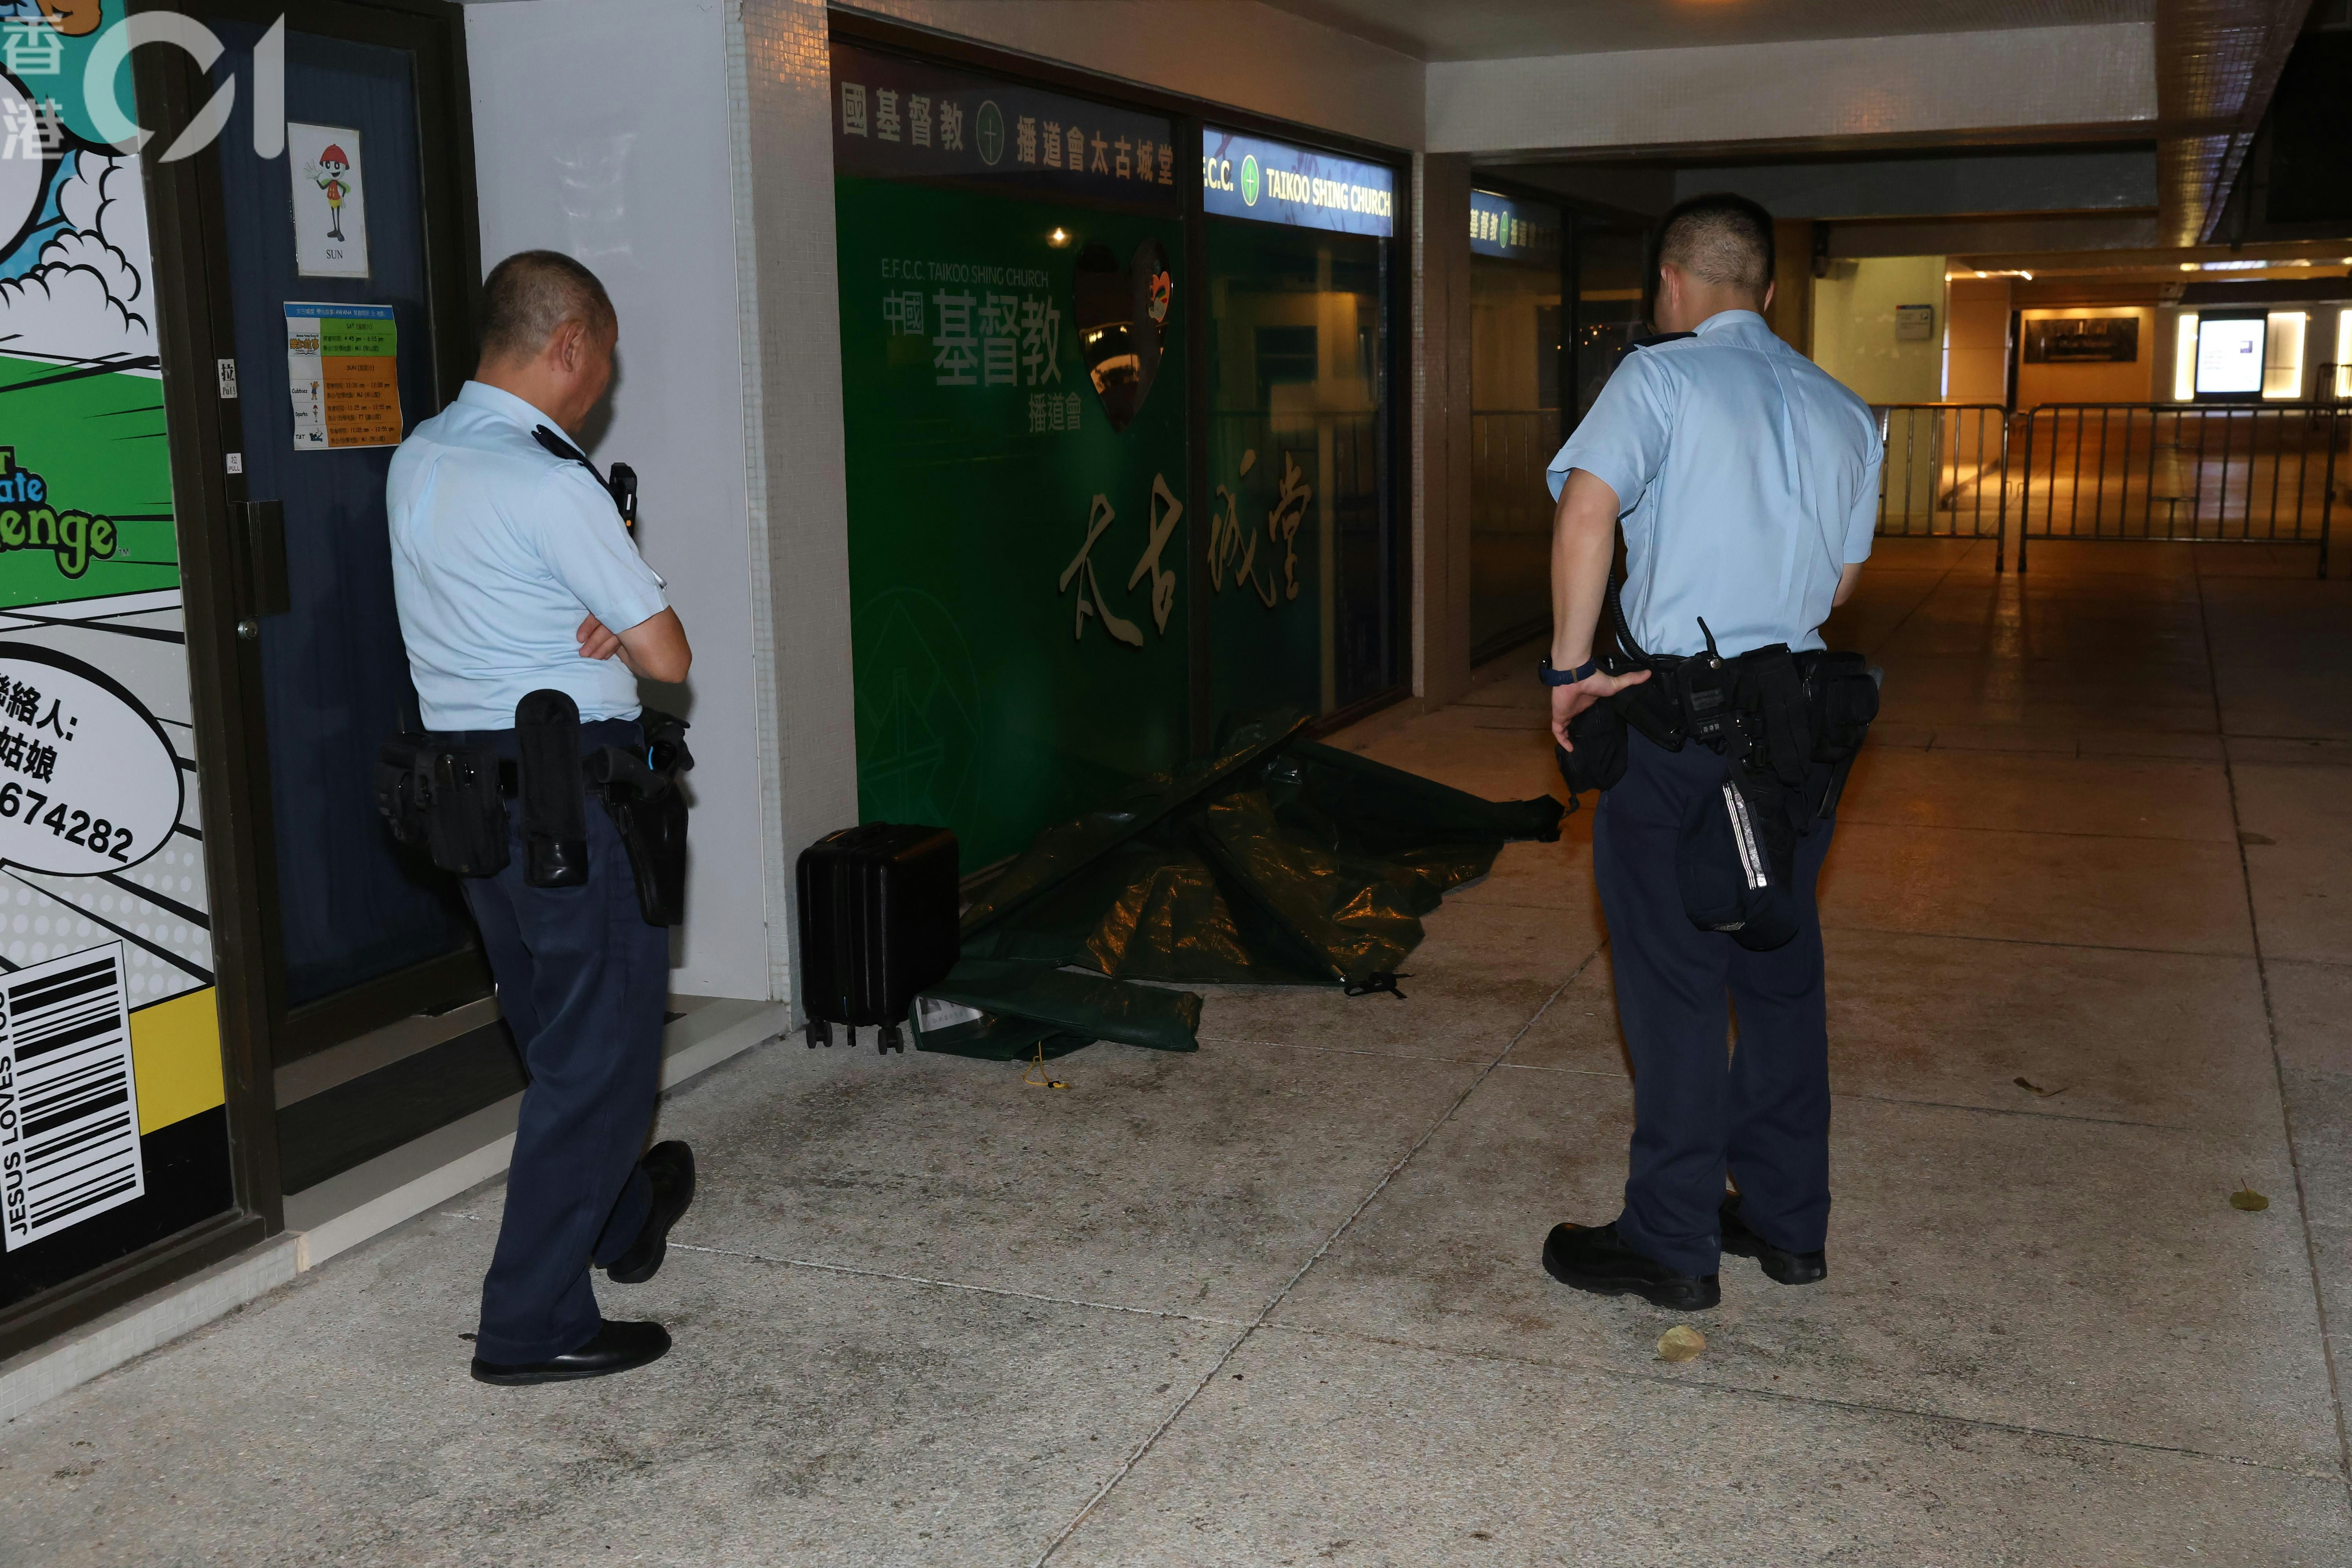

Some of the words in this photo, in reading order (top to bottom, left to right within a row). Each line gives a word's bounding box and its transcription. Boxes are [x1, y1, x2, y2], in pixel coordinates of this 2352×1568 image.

[841, 81, 964, 152] 國基督教
[1016, 114, 1174, 185] 播道會太古城堂
[1266, 168, 1310, 204] TAIKOO
[1312, 177, 1348, 210] SHING
[1350, 185, 1391, 217] CHURCH
[326, 249, 343, 260] SUN
[881, 258, 926, 280] E.F.C.C.
[927, 261, 969, 283] TAIKOO
[971, 265, 1004, 286] SHING
[1006, 267, 1049, 288] CHURCH
[883, 289, 925, 336] 中國
[932, 288, 1062, 387] 基督教
[221, 363, 234, 381] 拉
[1029, 391, 1082, 434] 播道會
[231, 455, 238, 464] 拉
[0, 509, 113, 574] enge
[0, 726, 58, 784] 姑娘
[0, 782, 134, 864] 674282
[0, 1056, 19, 1147] LOVES
[4, 1151, 28, 1236] JESUS
